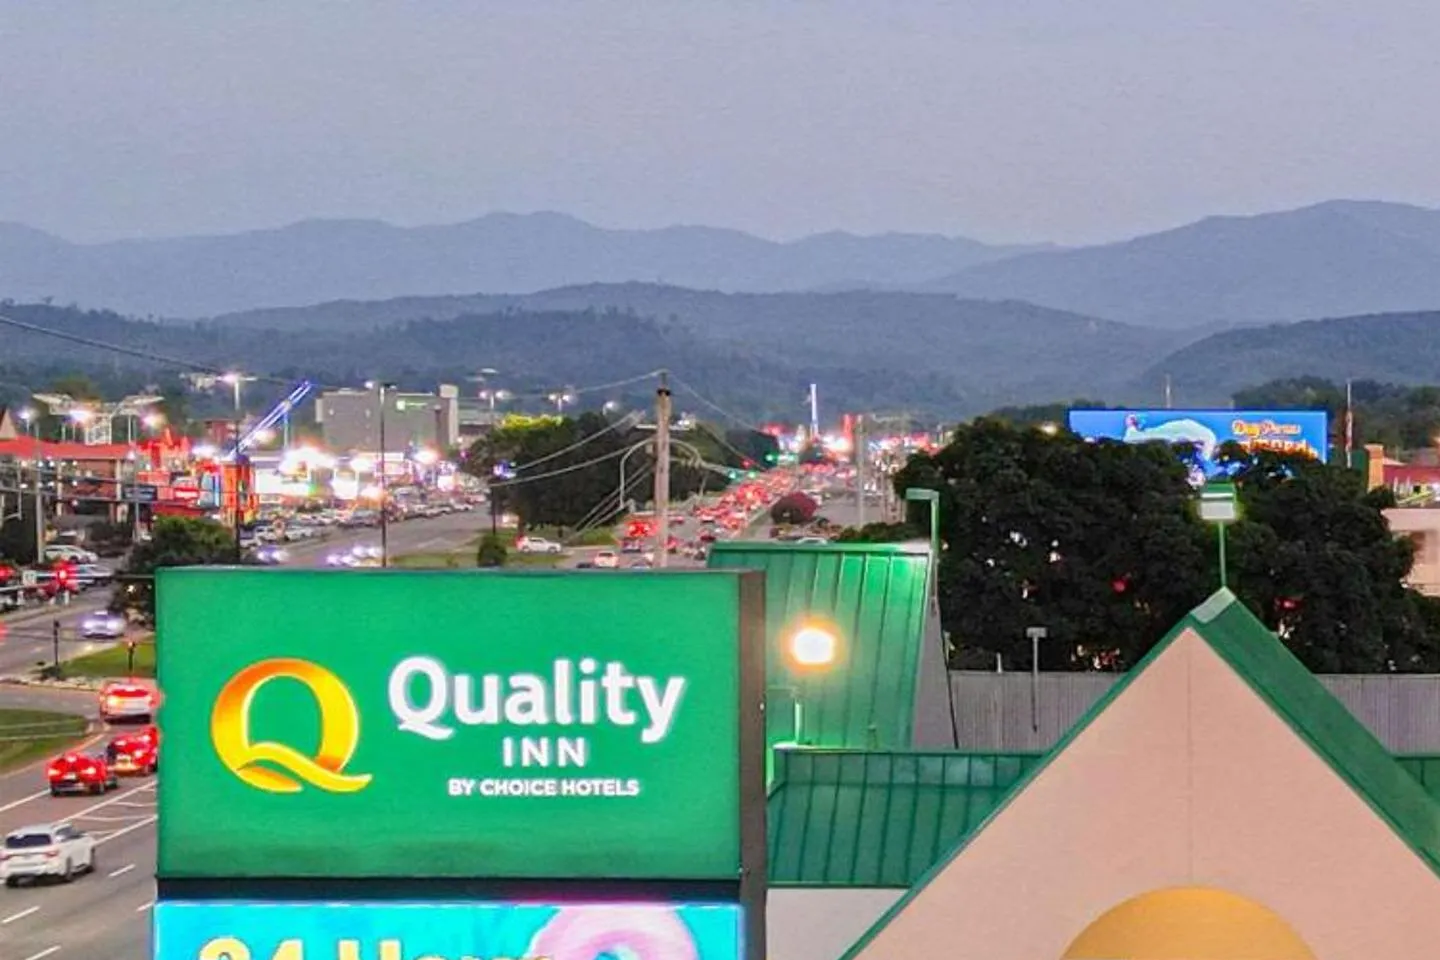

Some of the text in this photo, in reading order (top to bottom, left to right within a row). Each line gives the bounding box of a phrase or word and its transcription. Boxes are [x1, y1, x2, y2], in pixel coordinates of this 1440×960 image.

[388, 656, 686, 743] Quality
[502, 736, 587, 767] INN
[448, 778, 640, 796] BY CHOICE HOTELS
